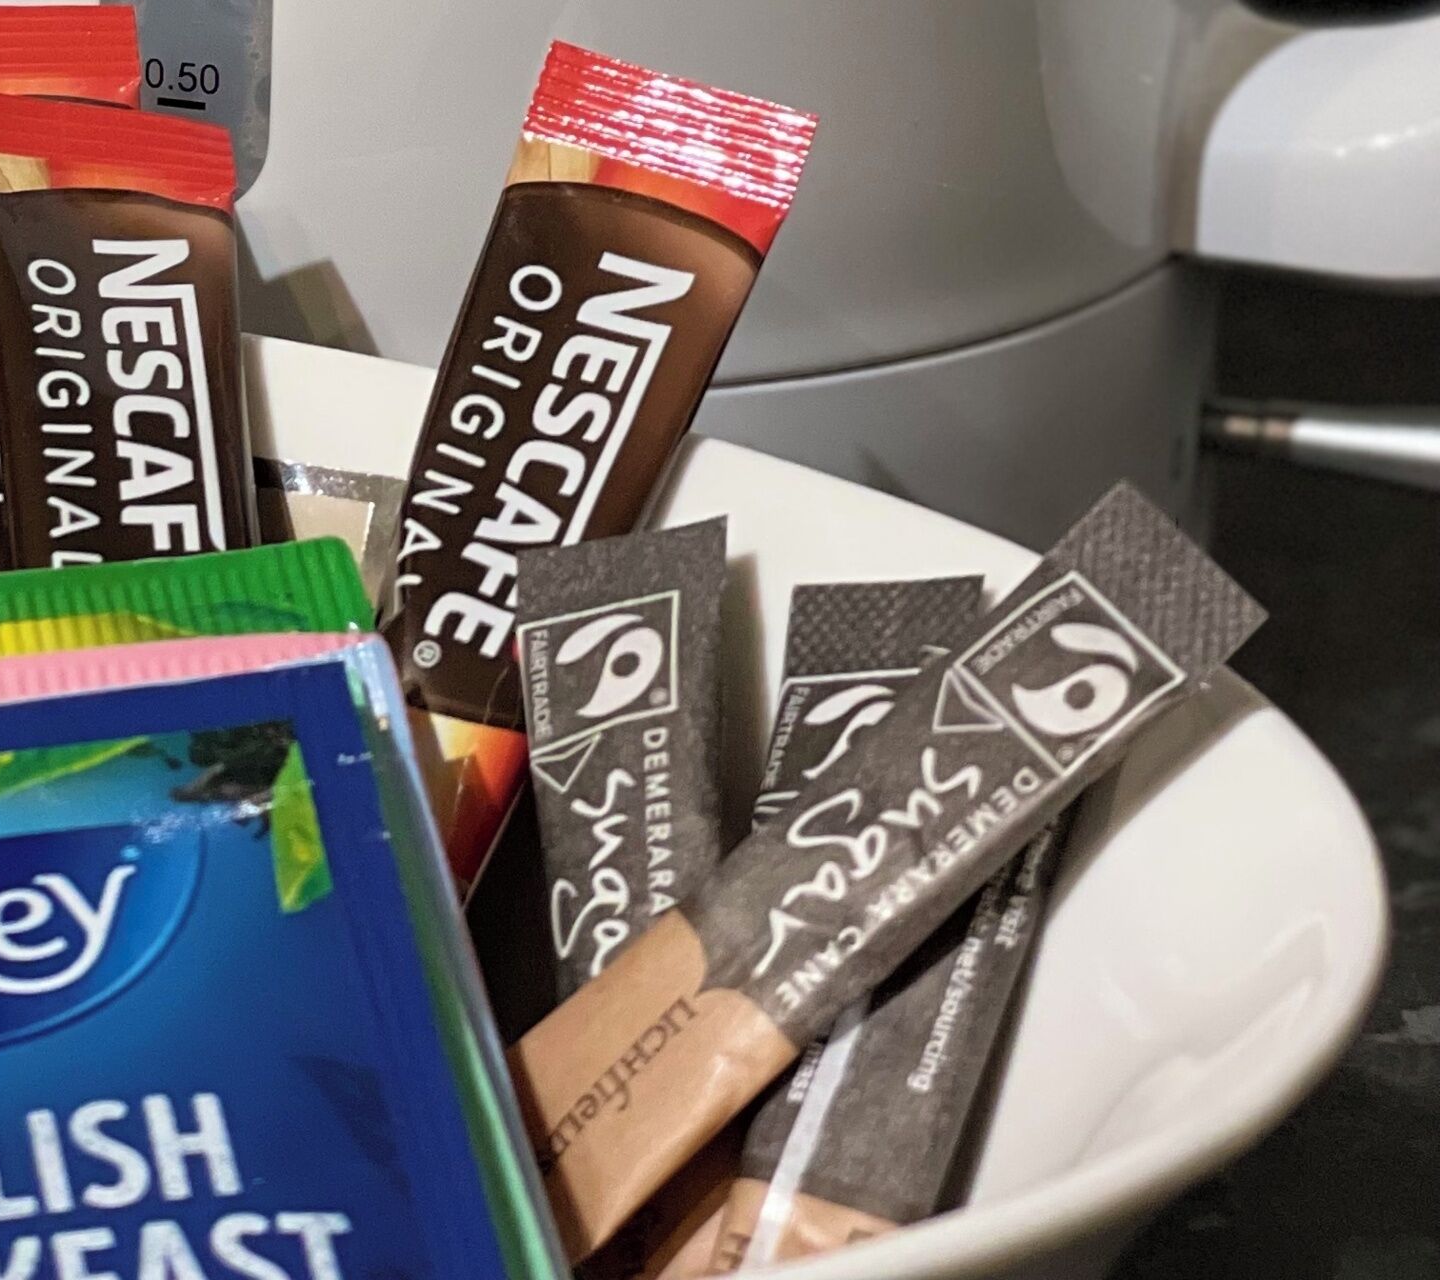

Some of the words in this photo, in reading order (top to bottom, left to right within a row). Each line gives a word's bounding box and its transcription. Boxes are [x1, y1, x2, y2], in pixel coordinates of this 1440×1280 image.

[144, 58, 220, 95] 0.50
[27, 258, 104, 570] ORIGINAL
[92, 239, 227, 553] NESCAF
[529, 628, 556, 740] FAIRTRADE
[551, 767, 637, 978] Suga
[642, 726, 678, 917] DEMERARA
[864, 764, 1044, 920] DEMERARA
[775, 925, 865, 1012] CANE
